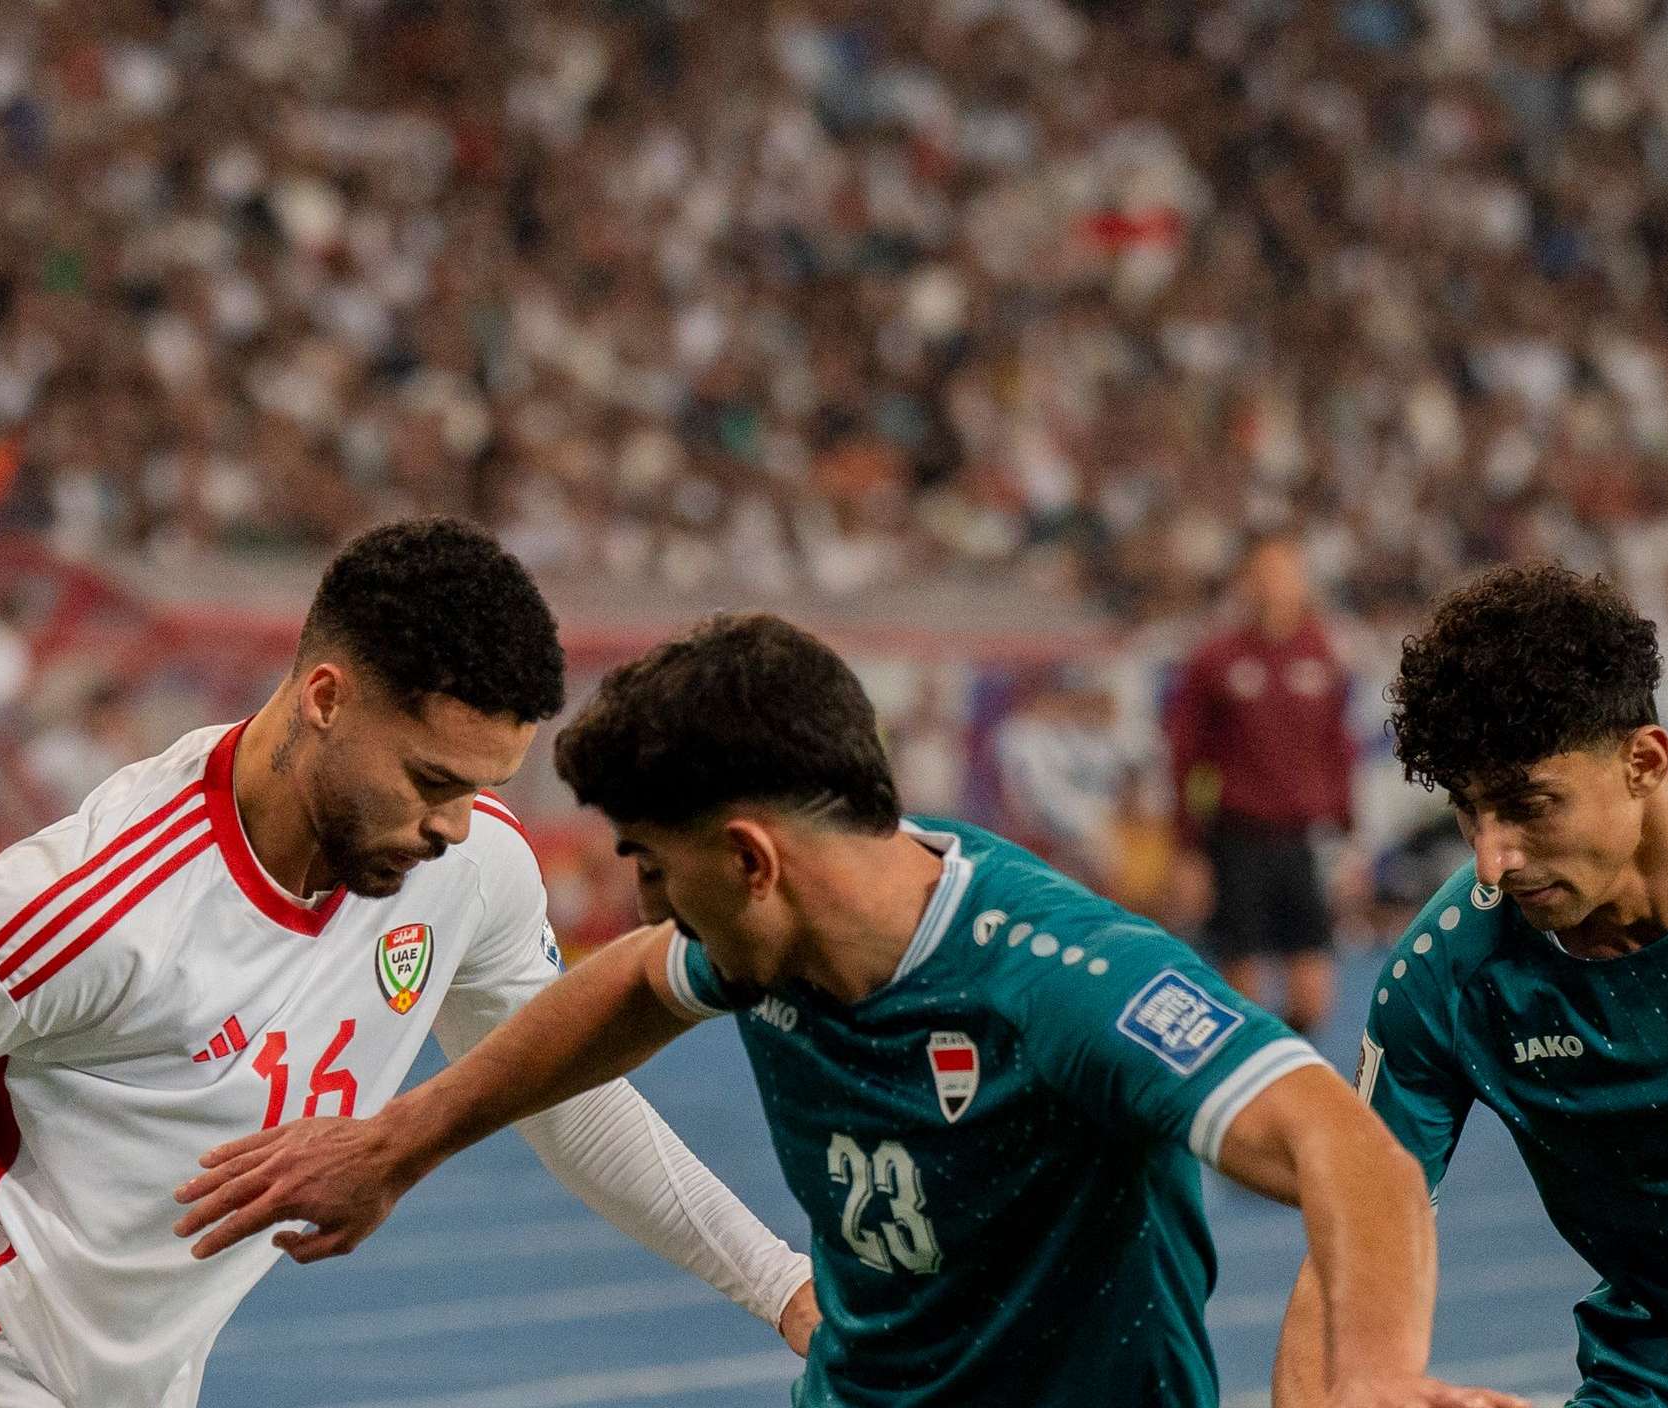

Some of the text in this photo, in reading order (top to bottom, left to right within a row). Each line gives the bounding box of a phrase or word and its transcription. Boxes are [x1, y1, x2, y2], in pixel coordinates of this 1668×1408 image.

[392, 948, 418, 964] UAE
[397, 963, 412, 976] FA
[1514, 1035, 1584, 1063] JAKO
[251, 1018, 358, 1130] 16
[827, 1132, 944, 1274] 23
